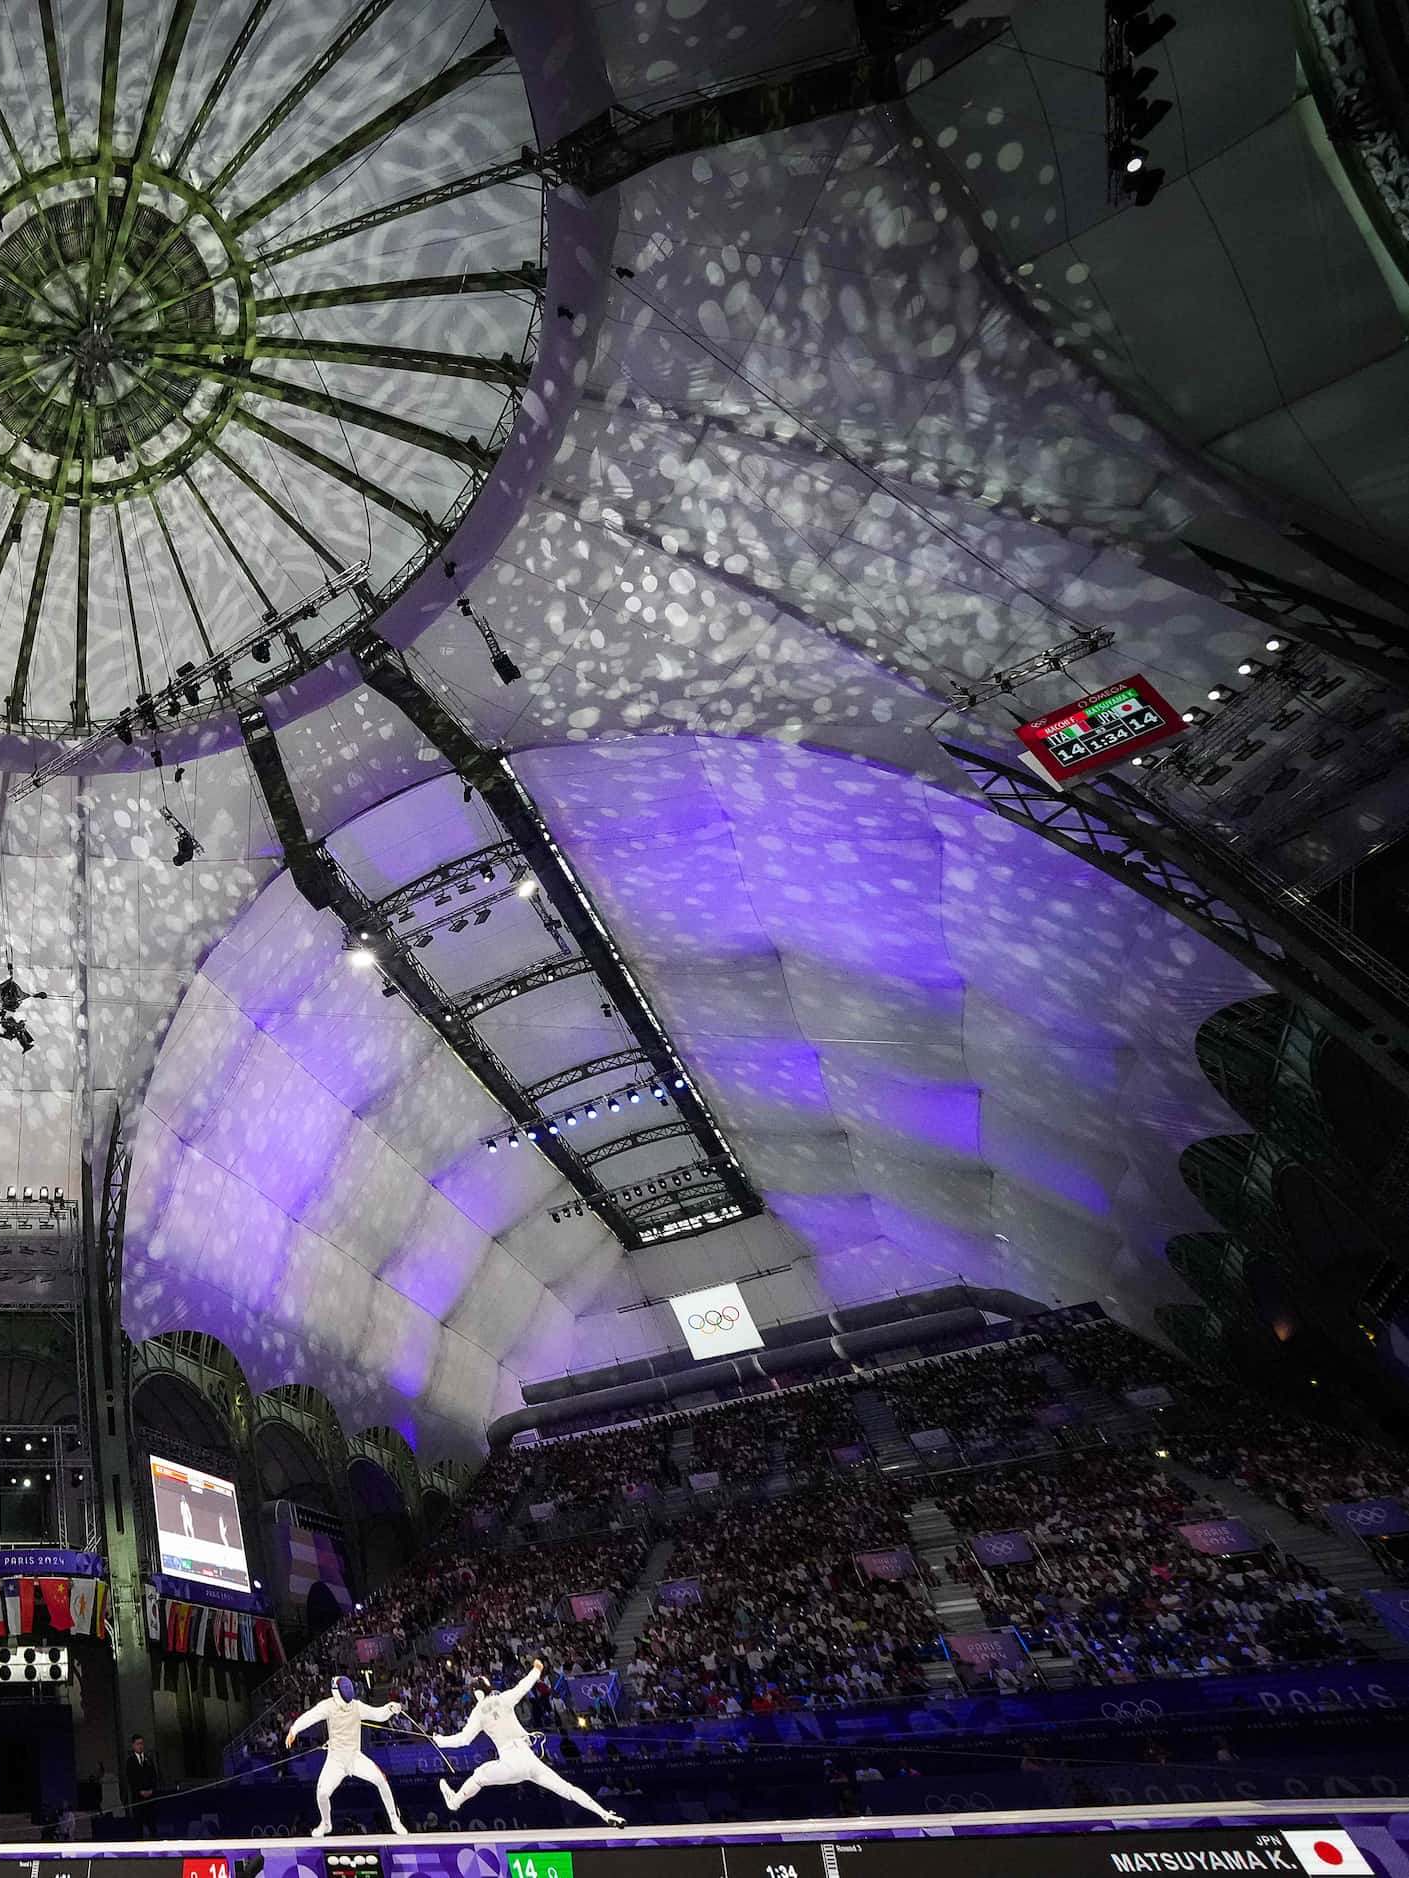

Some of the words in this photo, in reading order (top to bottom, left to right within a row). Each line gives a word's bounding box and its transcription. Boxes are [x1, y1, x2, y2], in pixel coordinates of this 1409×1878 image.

[1089, 684, 1127, 703] OMEGA
[1097, 708, 1120, 725] JPN
[1045, 720, 1070, 734] MACCHI
[1047, 731, 1072, 746] ITA
[1058, 743, 1086, 761] 14
[1091, 729, 1129, 750] 1:34
[1129, 712, 1159, 730] 14
[4, 1556, 35, 1566] PARIS
[38, 1556, 65, 1566] 2024
[1256, 1835, 1282, 1847] JPN
[513, 1858, 538, 1878] 14
[1111, 1851, 1261, 1873] MATSUYAMA
[1265, 1850, 1297, 1871] K.
